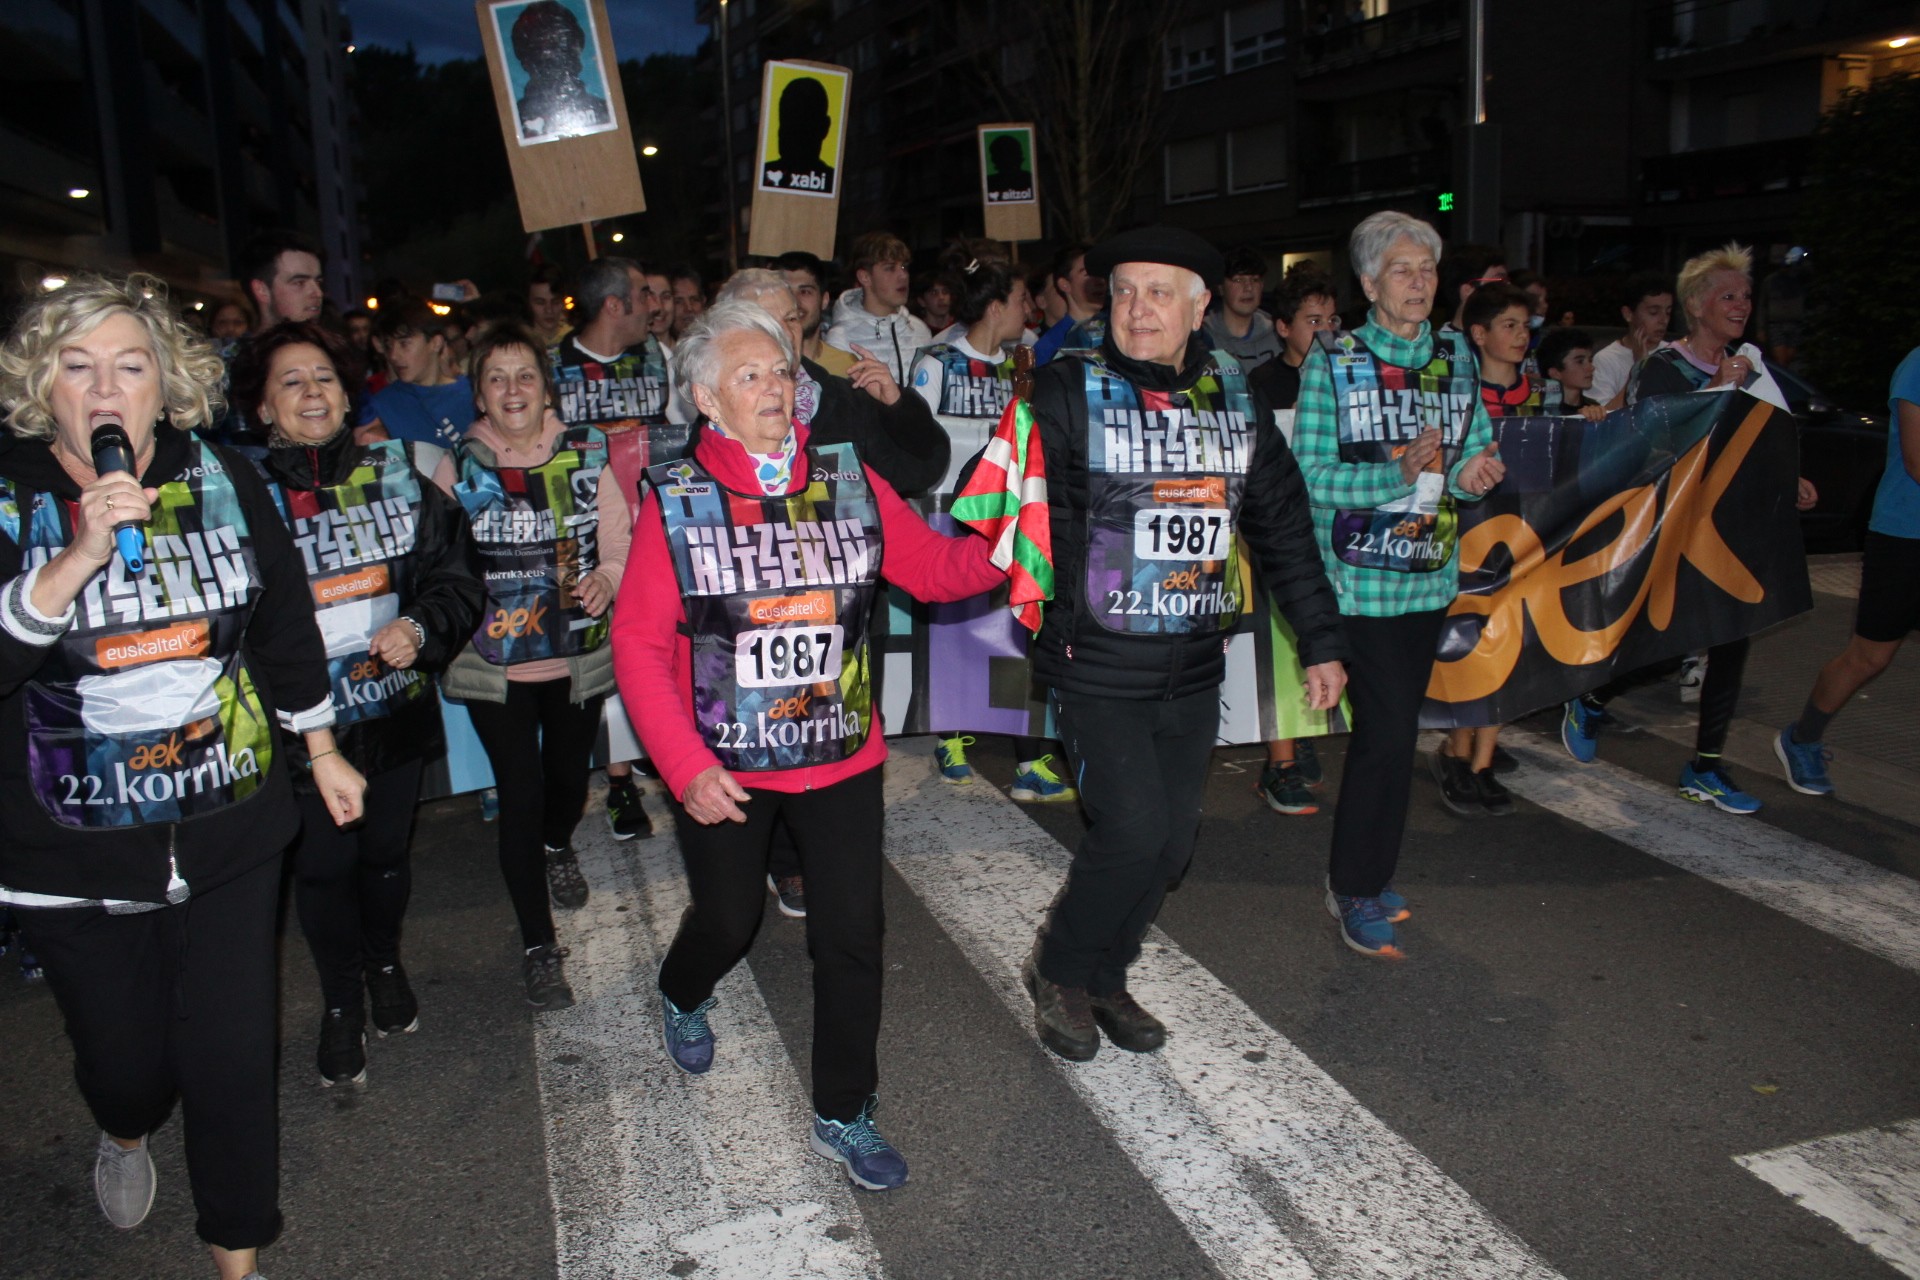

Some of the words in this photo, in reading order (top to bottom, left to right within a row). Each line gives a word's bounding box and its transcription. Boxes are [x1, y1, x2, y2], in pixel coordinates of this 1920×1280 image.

[790, 171, 826, 190] xabi
[1214, 365, 1239, 376] eitb
[1104, 409, 1251, 474] HITZEKIN
[830, 471, 860, 482] eitb
[1159, 487, 1210, 499] euskaltel
[1148, 515, 1221, 556] 1987
[686, 518, 872, 596] HITZEKIN
[321, 577, 372, 598] euskaltel
[1162, 564, 1200, 590] aek
[487, 594, 548, 639] aek
[757, 603, 814, 620] euskaltel
[106, 634, 183, 661] euskaltel
[749, 633, 832, 680] 1987
[768, 689, 811, 719] aek
[128, 732, 184, 771] aek
